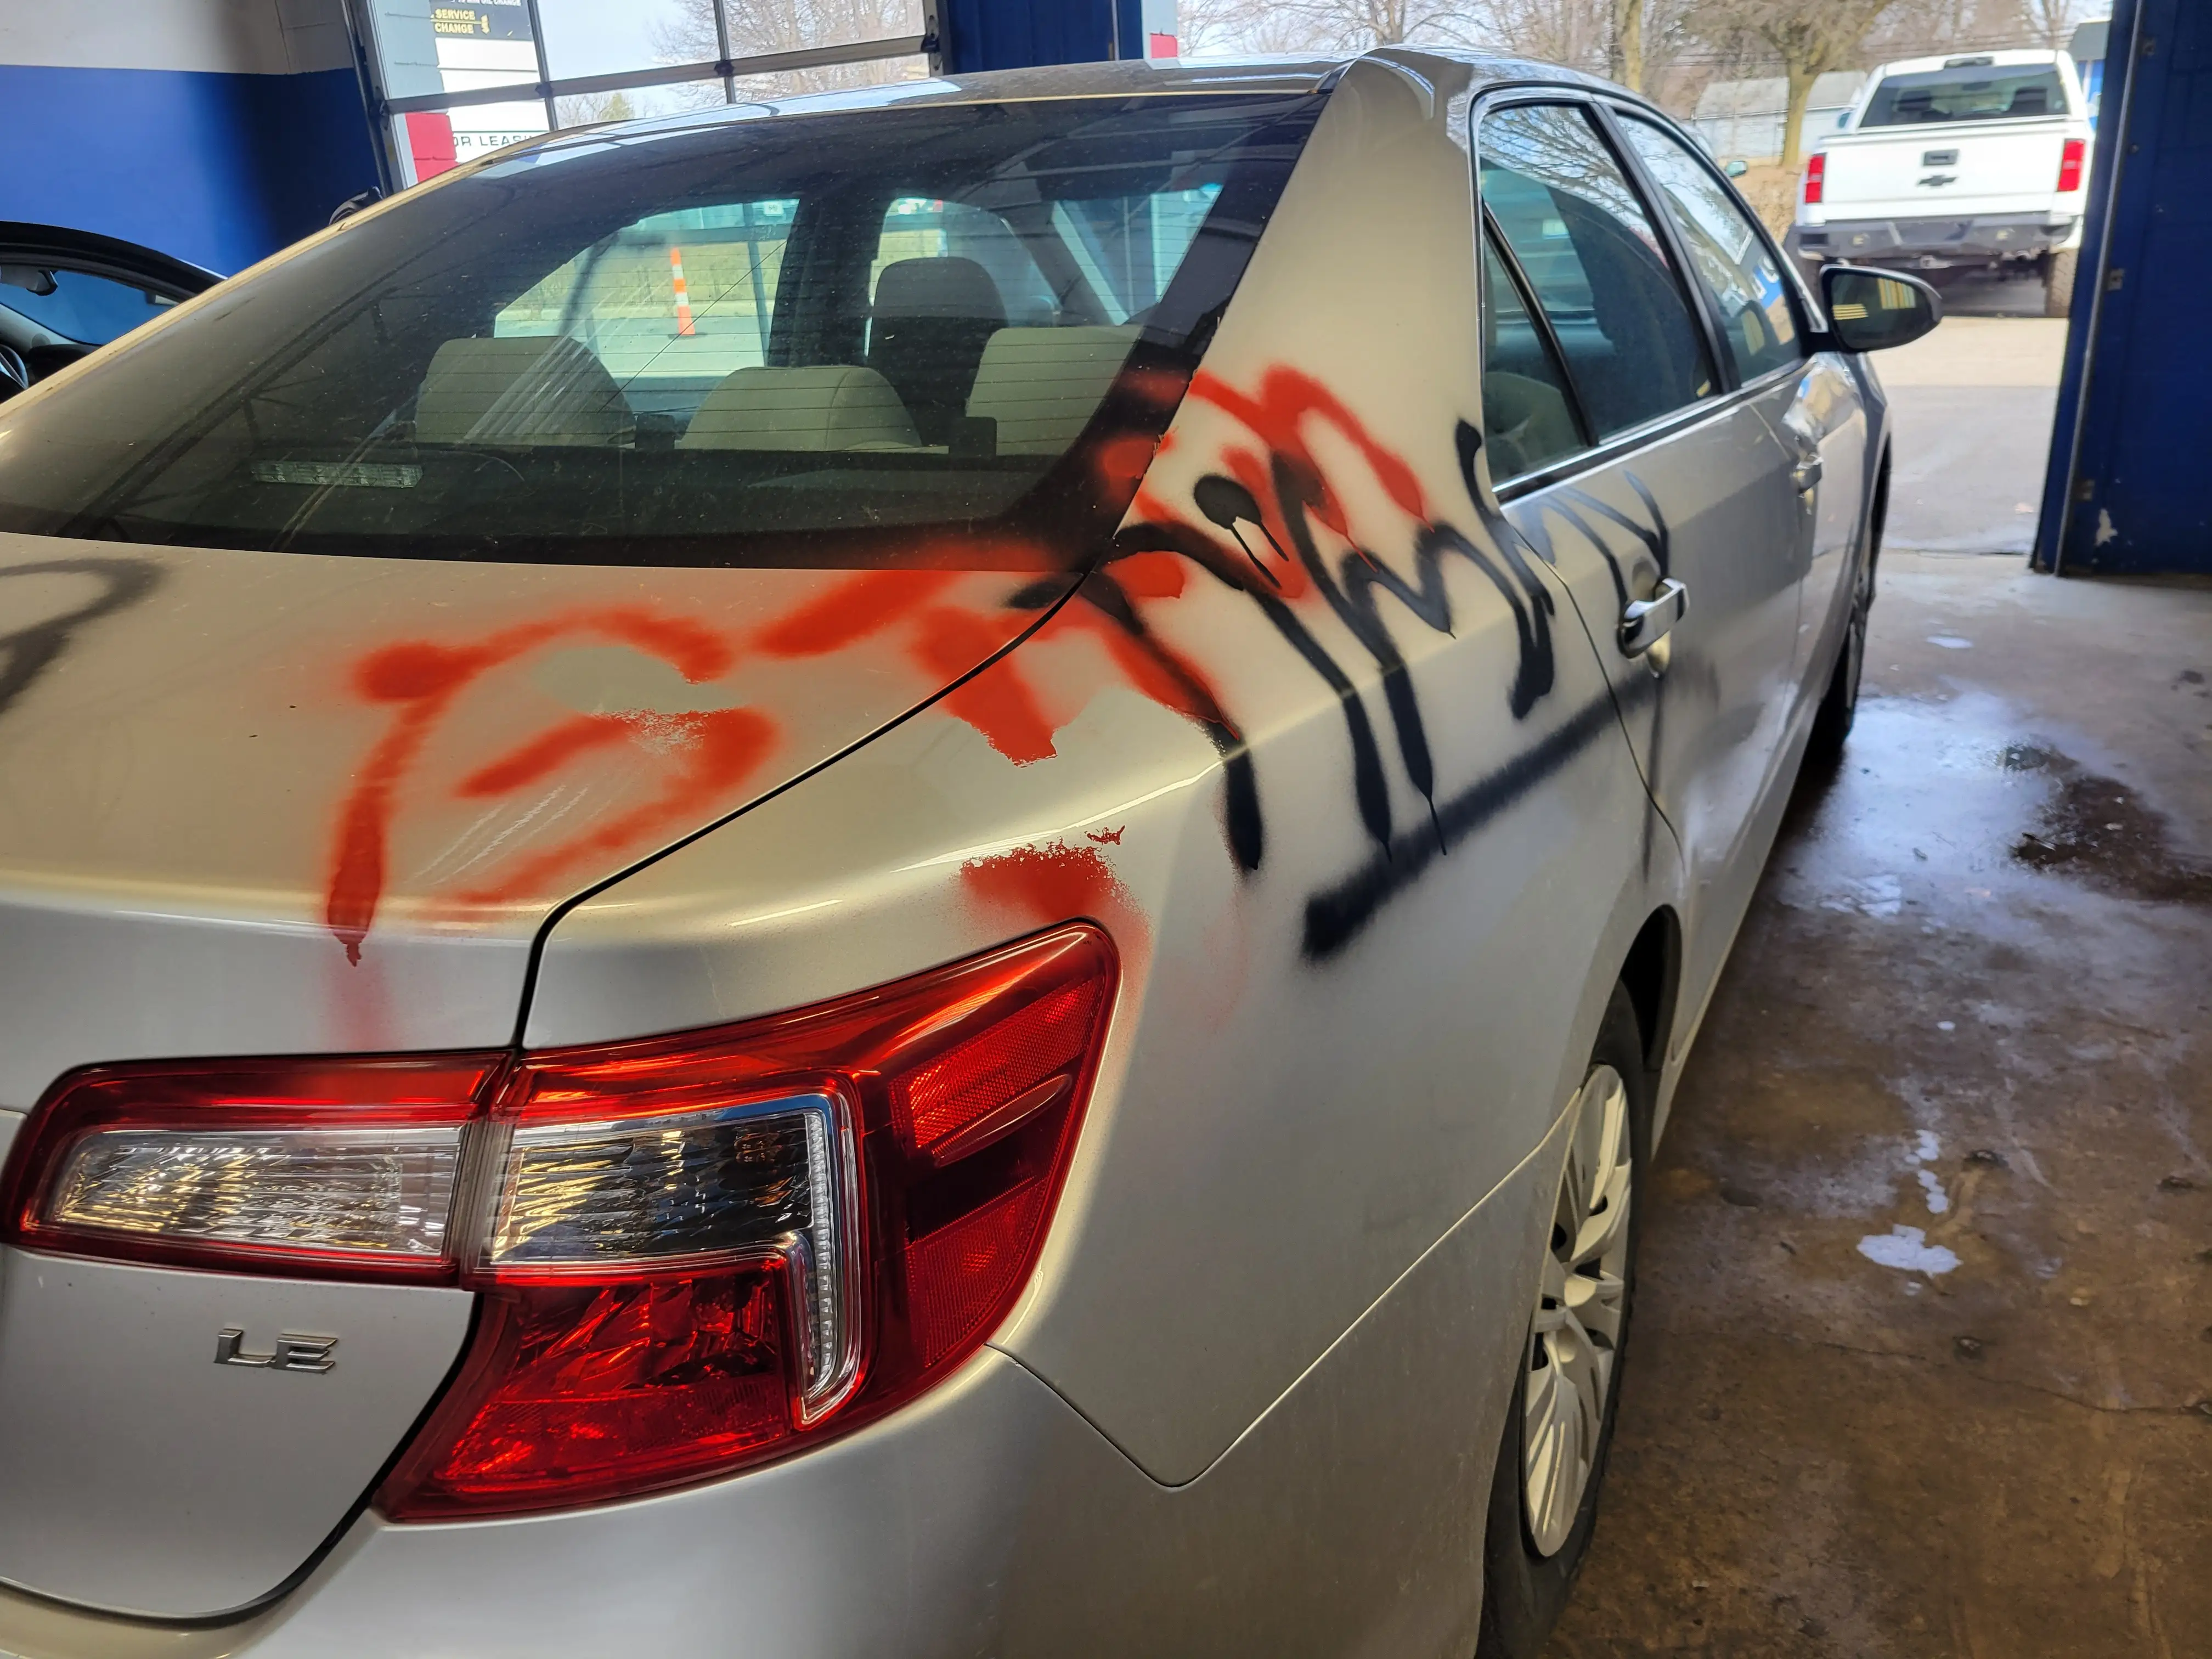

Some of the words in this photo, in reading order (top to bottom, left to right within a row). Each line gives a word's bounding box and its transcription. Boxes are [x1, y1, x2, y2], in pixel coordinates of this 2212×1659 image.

[435, 8, 476, 20] SERVICE
[435, 22, 474, 34] CHANGE
[214, 1328, 338, 1375] LE
